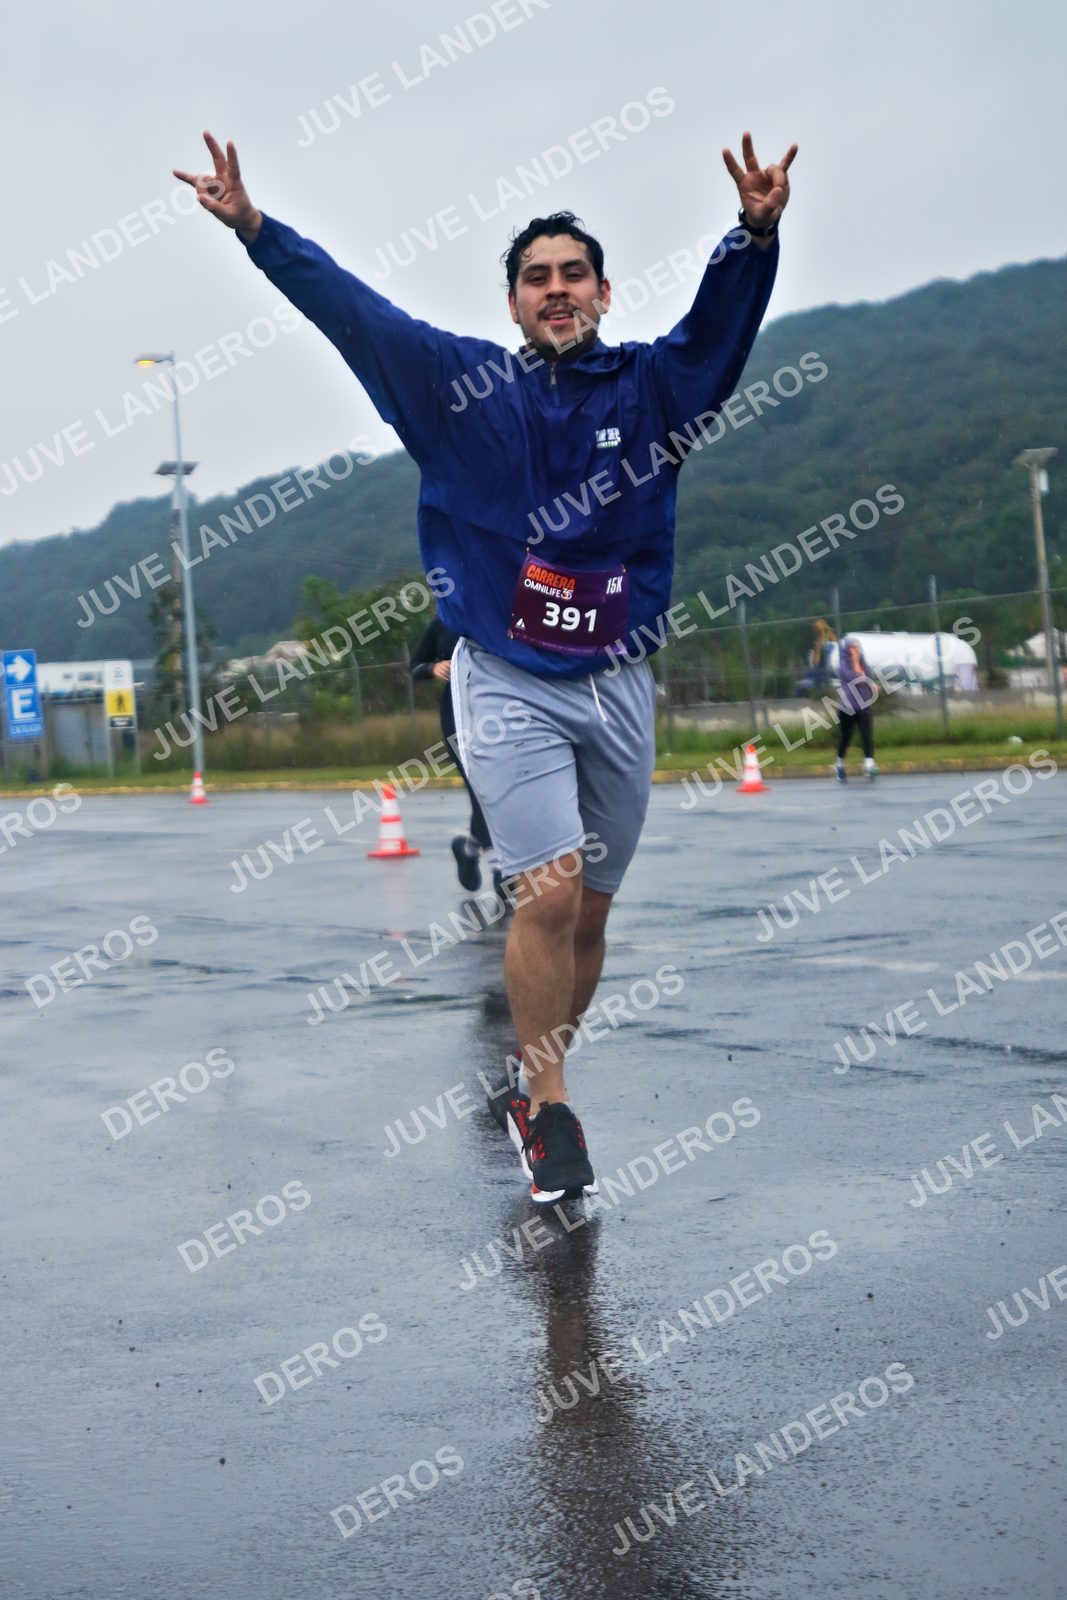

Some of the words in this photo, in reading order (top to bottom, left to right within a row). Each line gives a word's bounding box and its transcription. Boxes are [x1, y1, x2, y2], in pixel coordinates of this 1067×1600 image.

[524, 578, 561, 598] OMNILIFE
[526, 564, 576, 591] CARRERA
[606, 576, 623, 594] 15K
[542, 601, 597, 632] 391
[11, 688, 36, 719] E
